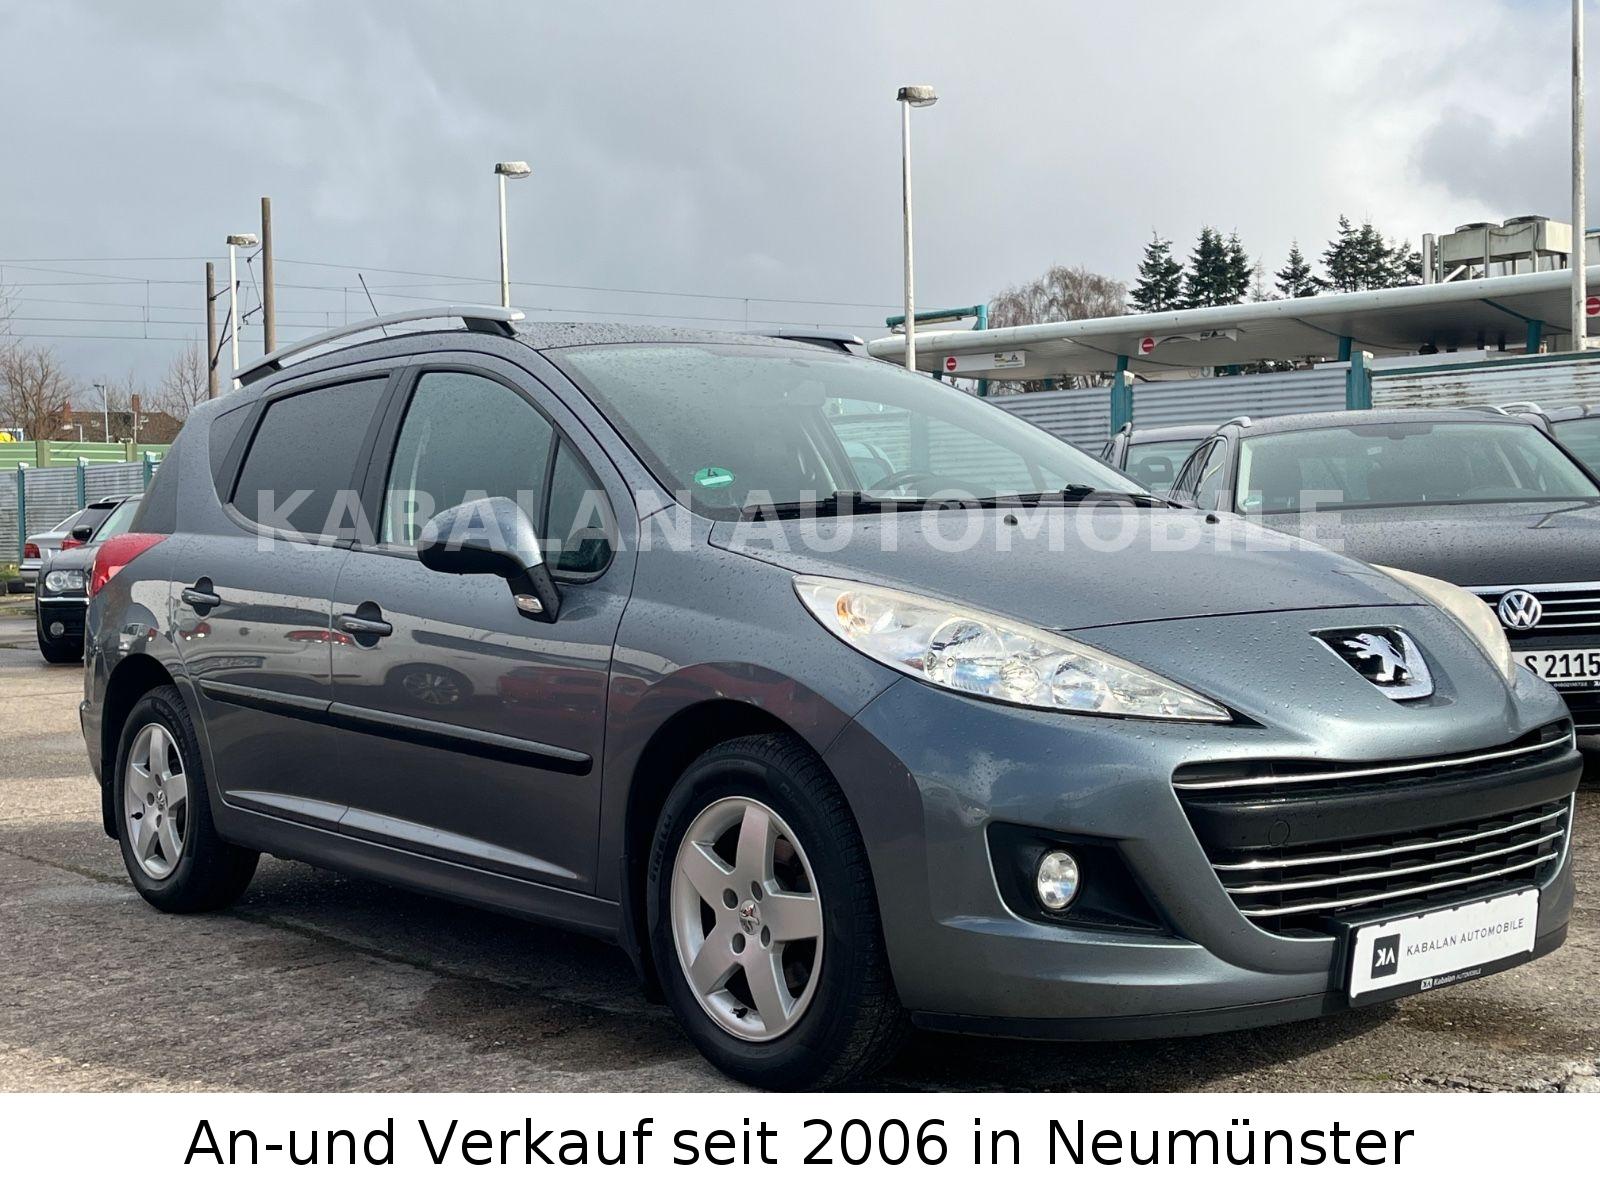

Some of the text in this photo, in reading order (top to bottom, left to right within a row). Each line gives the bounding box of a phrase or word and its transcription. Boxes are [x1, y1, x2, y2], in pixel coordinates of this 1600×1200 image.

[1544, 653, 1600, 678] 2115
[1406, 918, 1525, 956] KABALAN AUTOMOBILE
